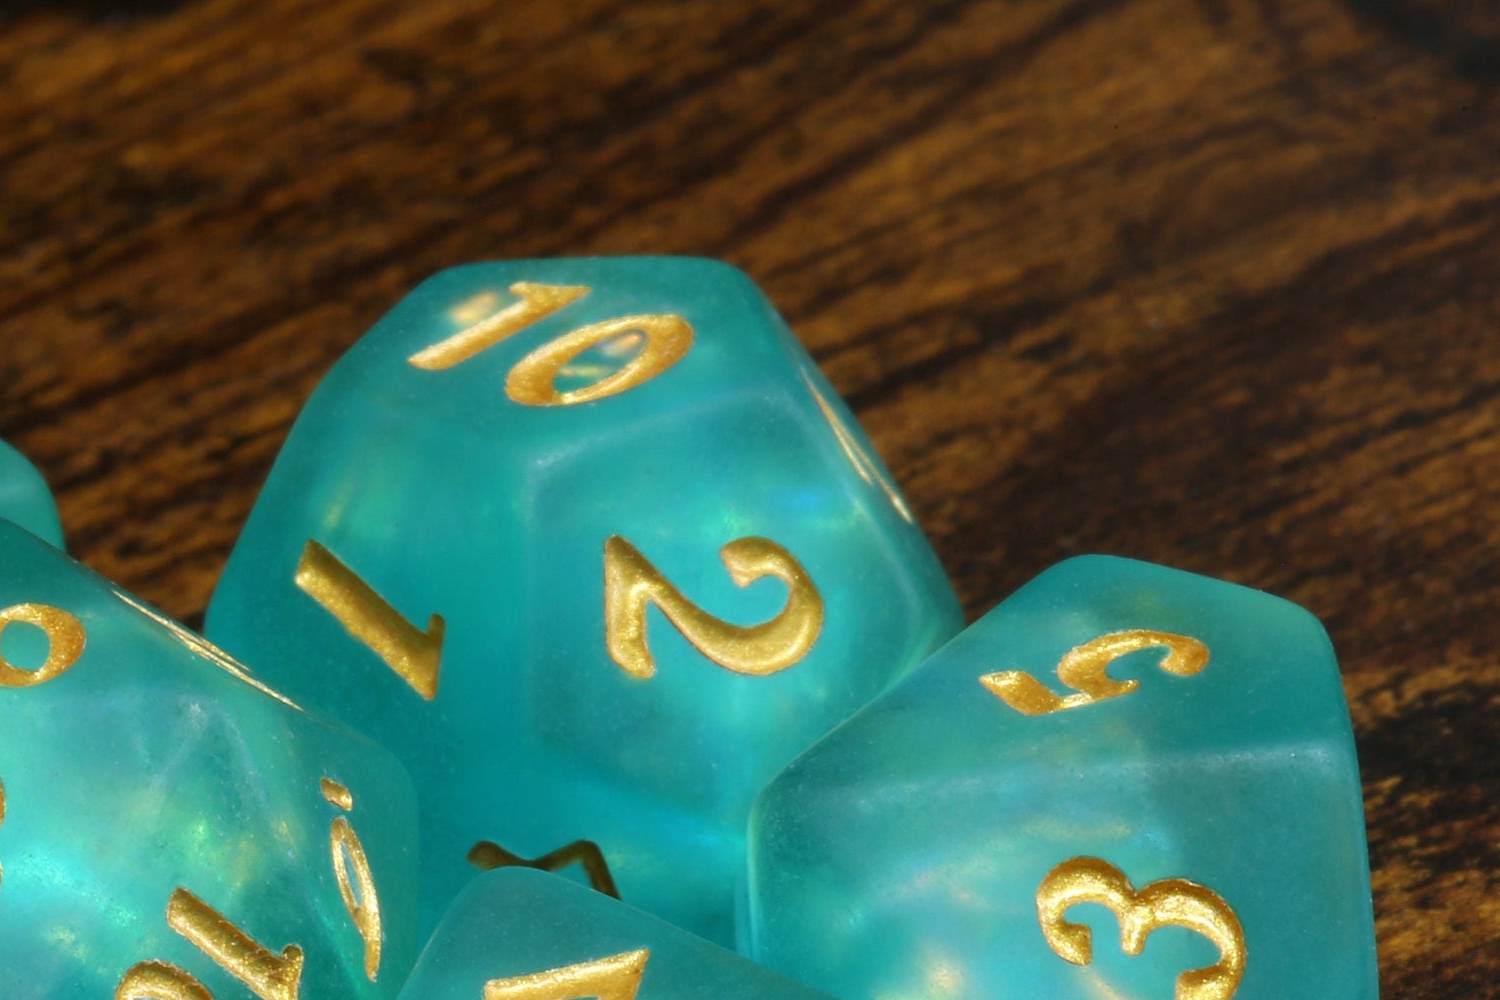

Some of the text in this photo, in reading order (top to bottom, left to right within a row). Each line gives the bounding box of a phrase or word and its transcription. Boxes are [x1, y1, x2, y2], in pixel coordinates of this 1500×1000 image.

[408, 281, 695, 407] 10
[295, 539, 446, 701] 1
[604, 535, 824, 677] 2
[979, 629, 1209, 716] 5
